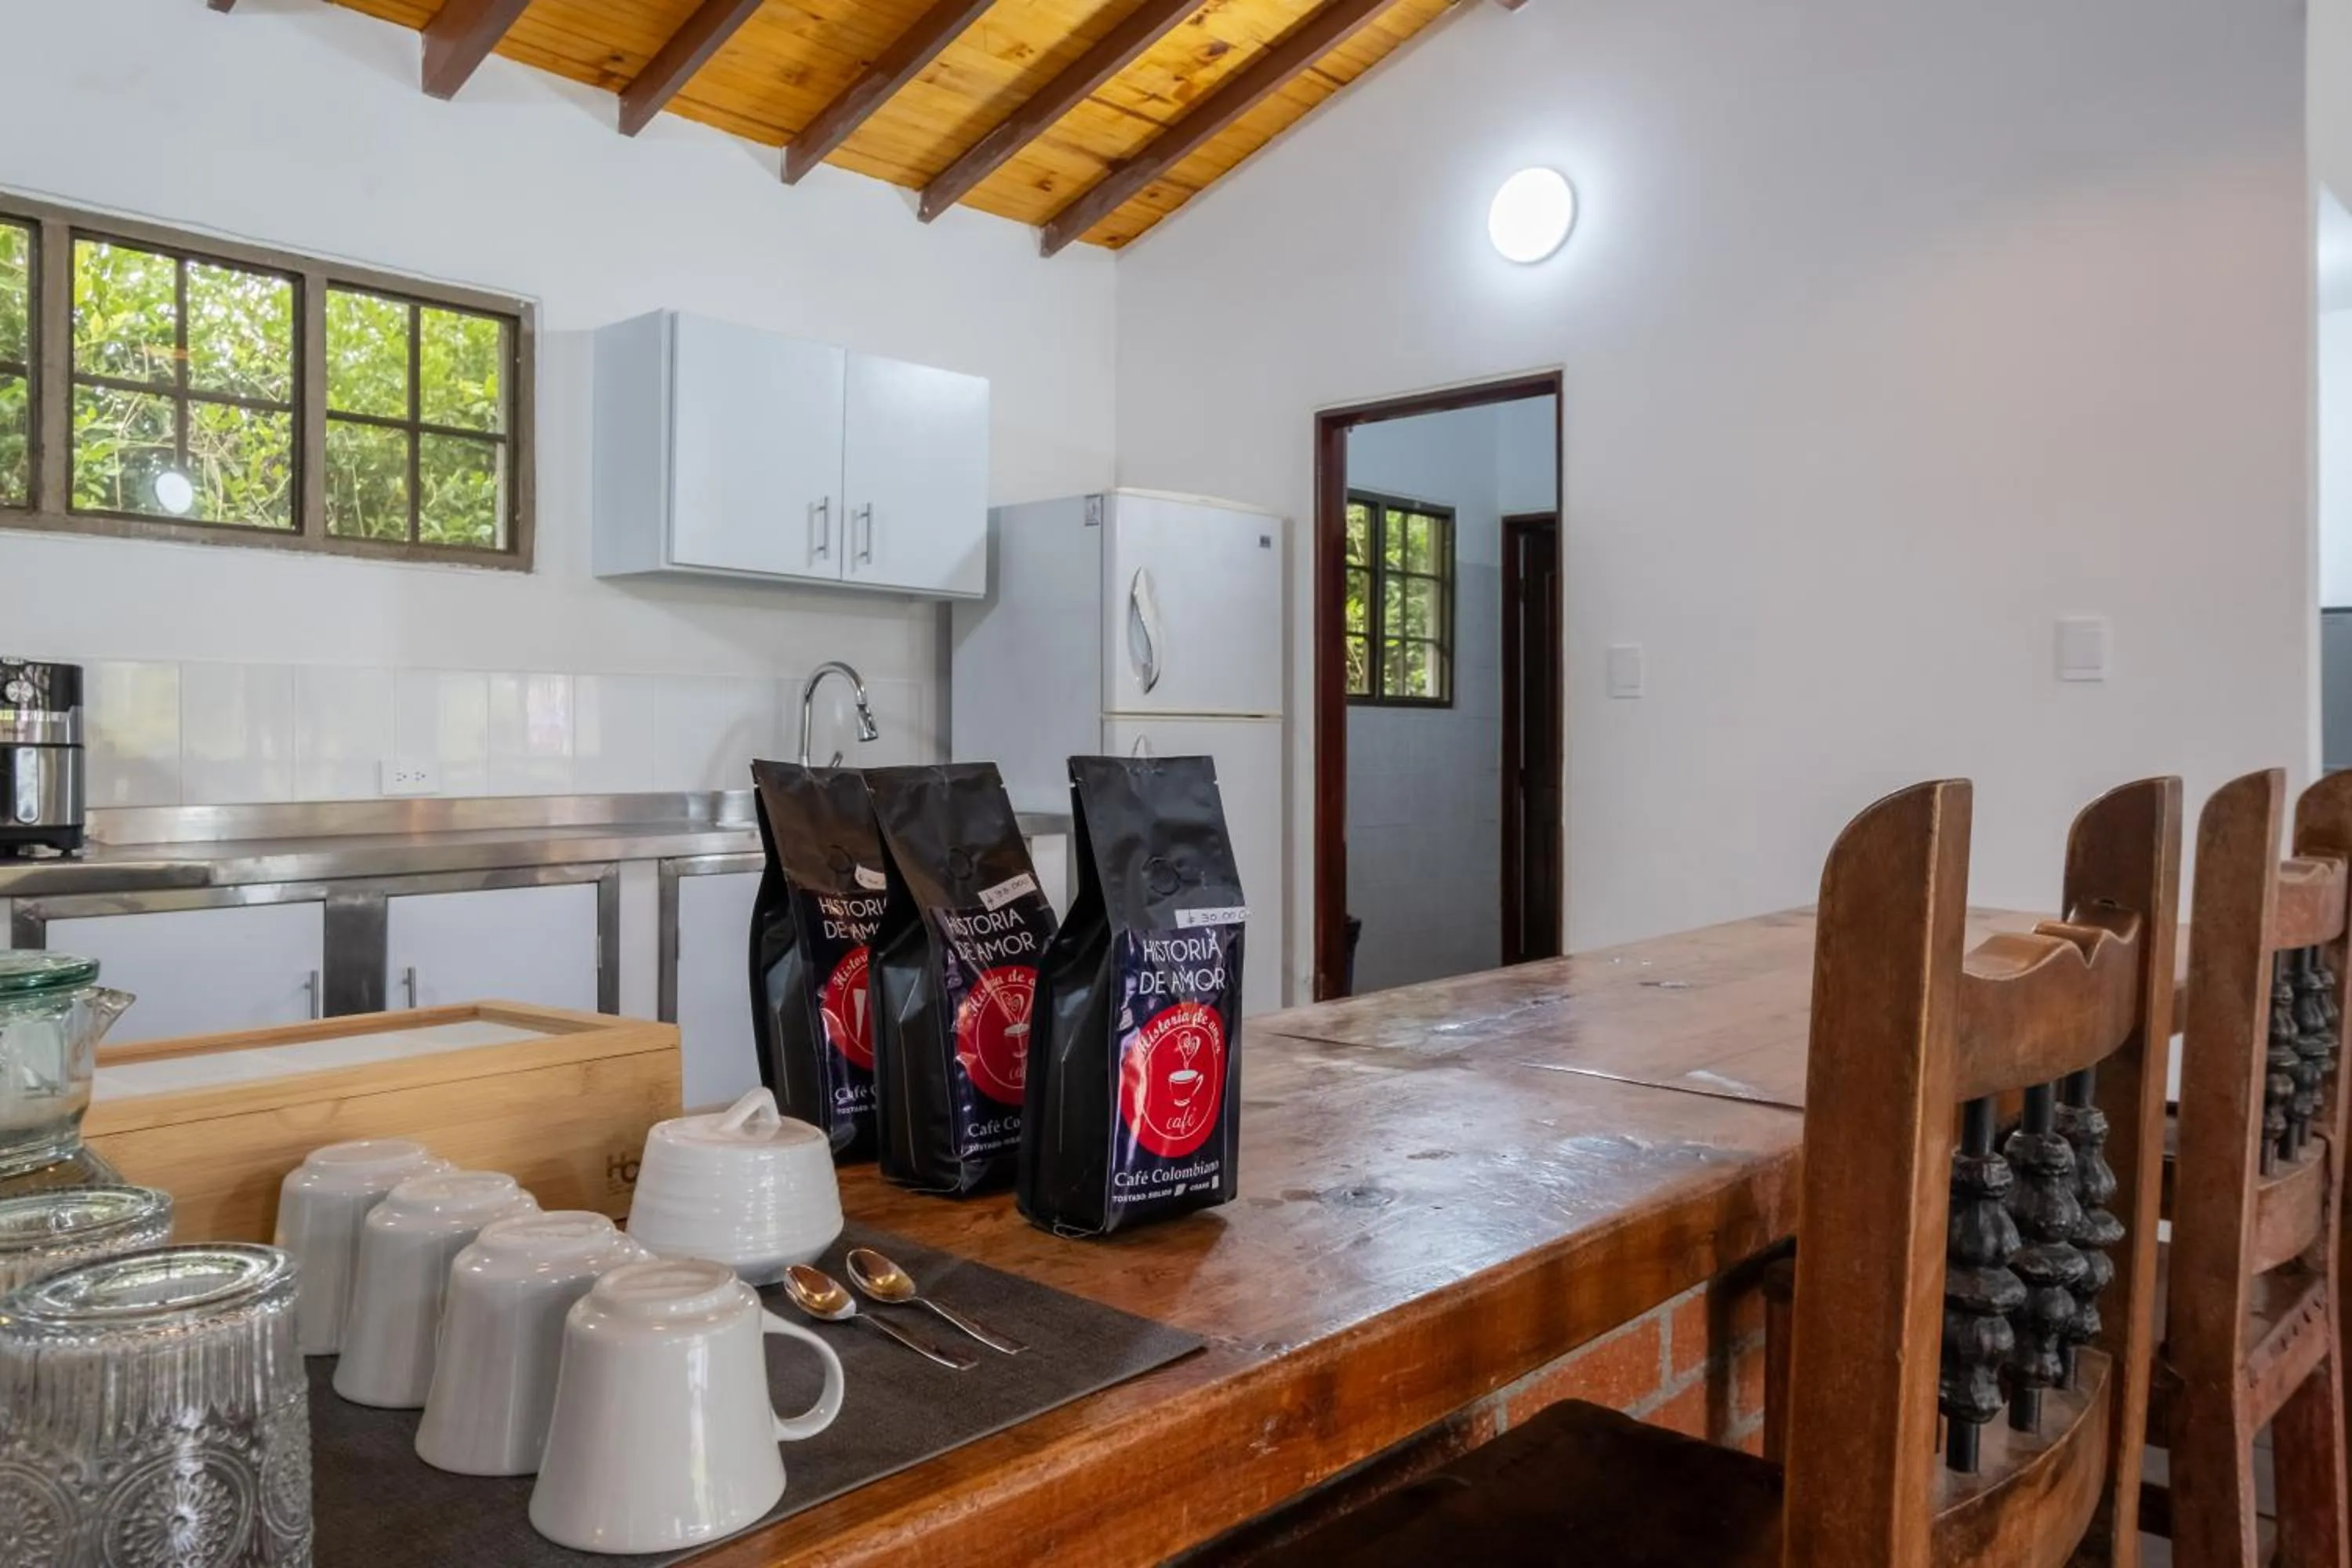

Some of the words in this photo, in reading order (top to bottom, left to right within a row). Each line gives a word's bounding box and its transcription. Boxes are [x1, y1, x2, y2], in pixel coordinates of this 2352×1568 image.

[818, 895, 887, 917] HISTORI
[824, 920, 849, 938] DE
[851, 921, 880, 939] AM
[944, 908, 1025, 936] HISTORIA
[955, 941, 976, 961] DE
[976, 931, 1036, 962] AMOR
[1143, 936, 1223, 962] HISTORIA
[1139, 970, 1166, 994] DE
[1171, 967, 1225, 992] AMOR
[967, 1119, 1001, 1138] Café
[1114, 1170, 1149, 1187] Café
